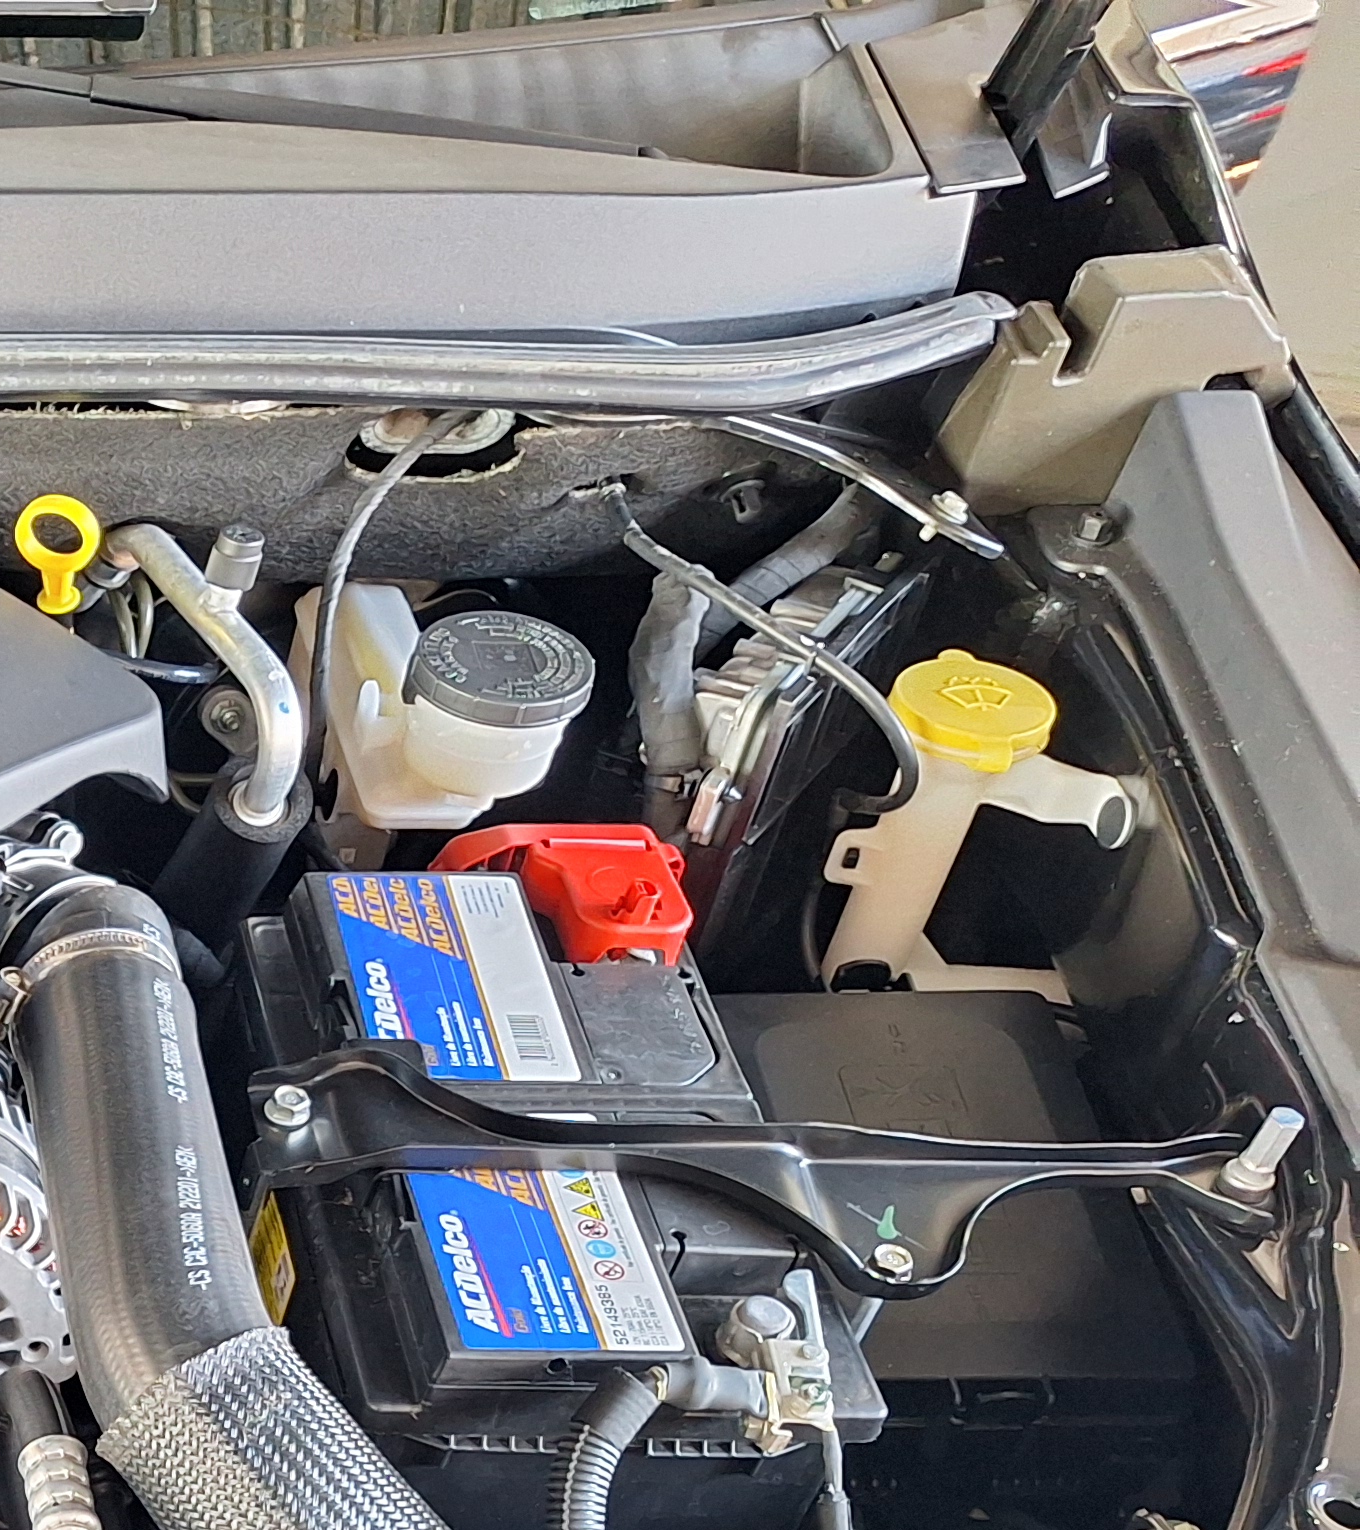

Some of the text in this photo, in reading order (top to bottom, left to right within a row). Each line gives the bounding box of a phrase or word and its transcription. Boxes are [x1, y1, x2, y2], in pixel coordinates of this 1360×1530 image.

[417, 879, 456, 957] ACDelco
[439, 1213, 500, 1333] ACDelco
[595, 1284, 629, 1345] 52149385
